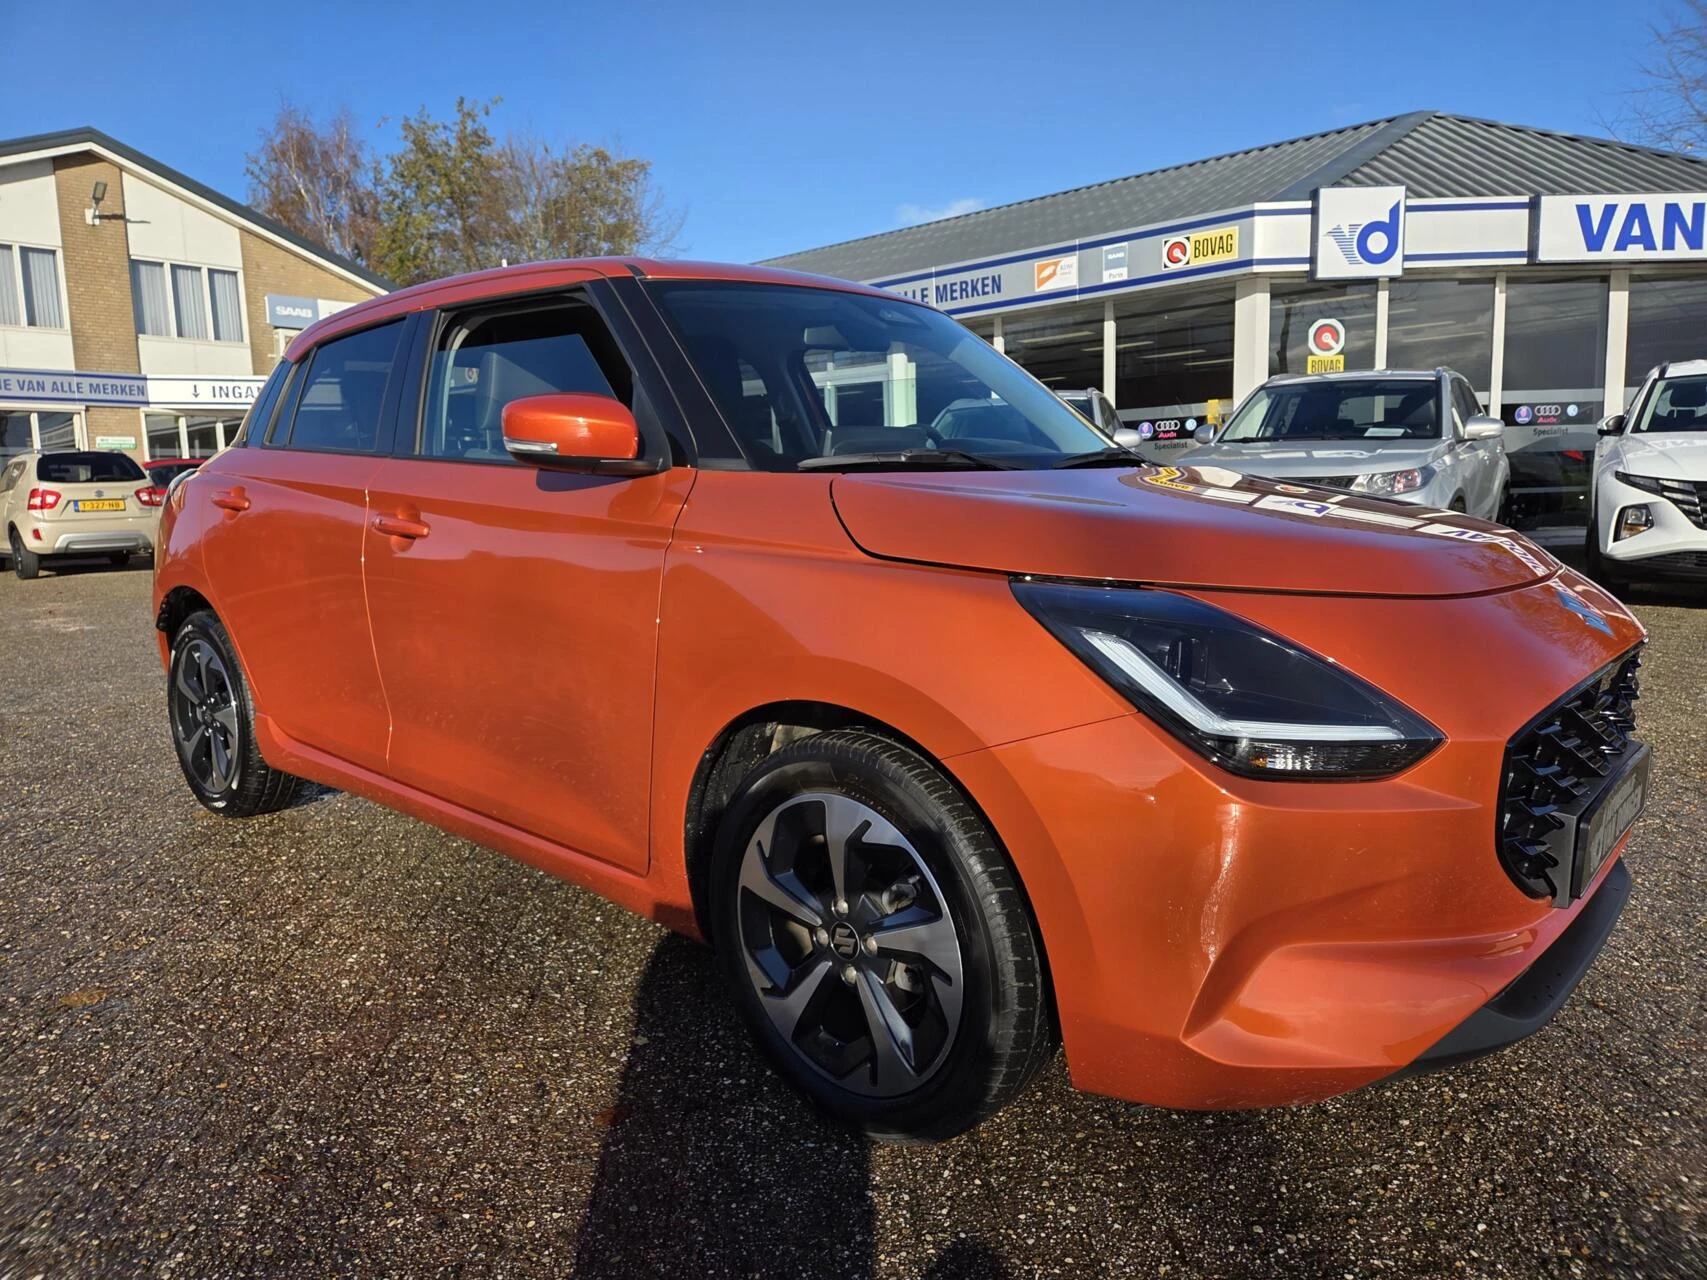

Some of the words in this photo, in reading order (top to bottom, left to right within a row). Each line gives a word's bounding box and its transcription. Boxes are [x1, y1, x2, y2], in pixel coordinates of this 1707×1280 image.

[1575, 202, 1706, 252] VAN
[1193, 234, 1233, 259] BOVAG
[935, 274, 1002, 304] MERKEN
[275, 305, 313, 319] SAAB
[16, 378, 46, 392] VAN
[51, 381, 84, 394] ALLE
[89, 383, 146, 397] MERKEN
[1154, 441, 1189, 451] Specialist
